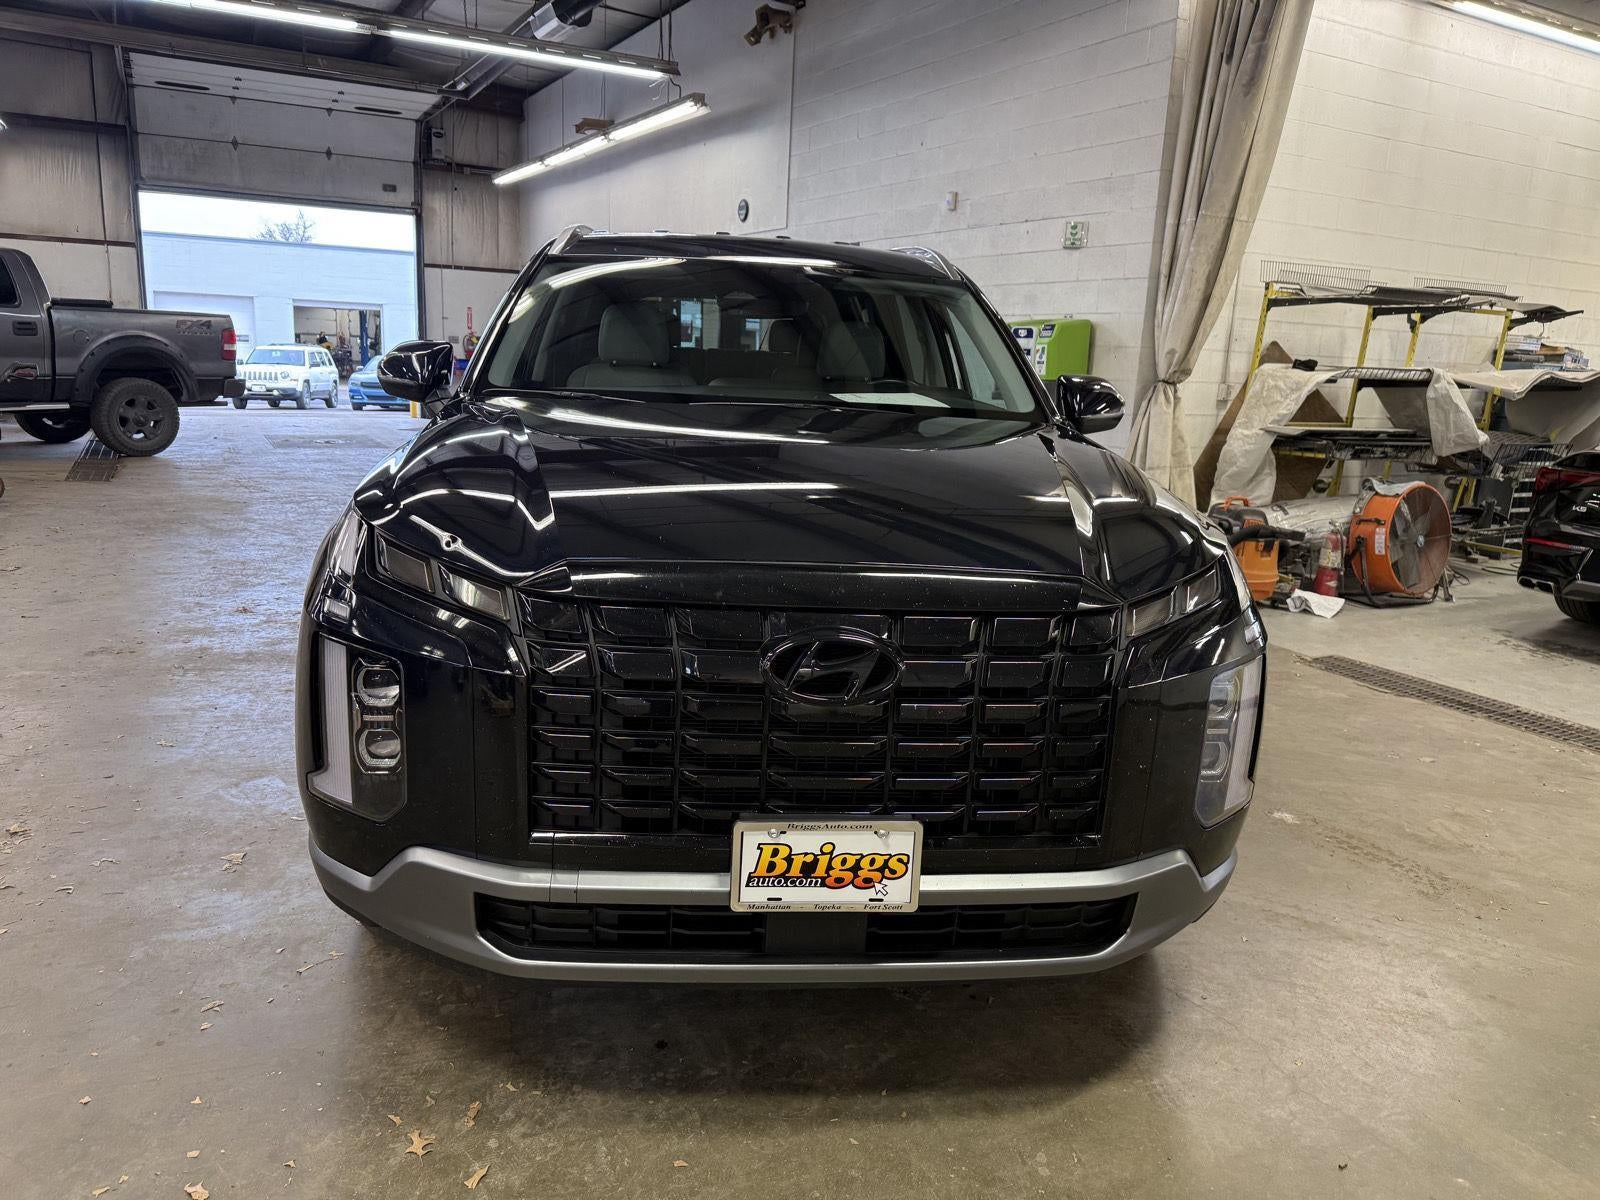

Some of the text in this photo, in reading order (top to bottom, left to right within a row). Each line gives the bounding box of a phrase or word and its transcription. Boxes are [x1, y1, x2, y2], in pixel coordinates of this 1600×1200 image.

[786, 823, 873, 831] BriggsAuto.com
[750, 842, 910, 890] Briggs
[749, 876, 822, 887] auto.com
[746, 903, 904, 911] Manhattan Topeka Fort Scott
